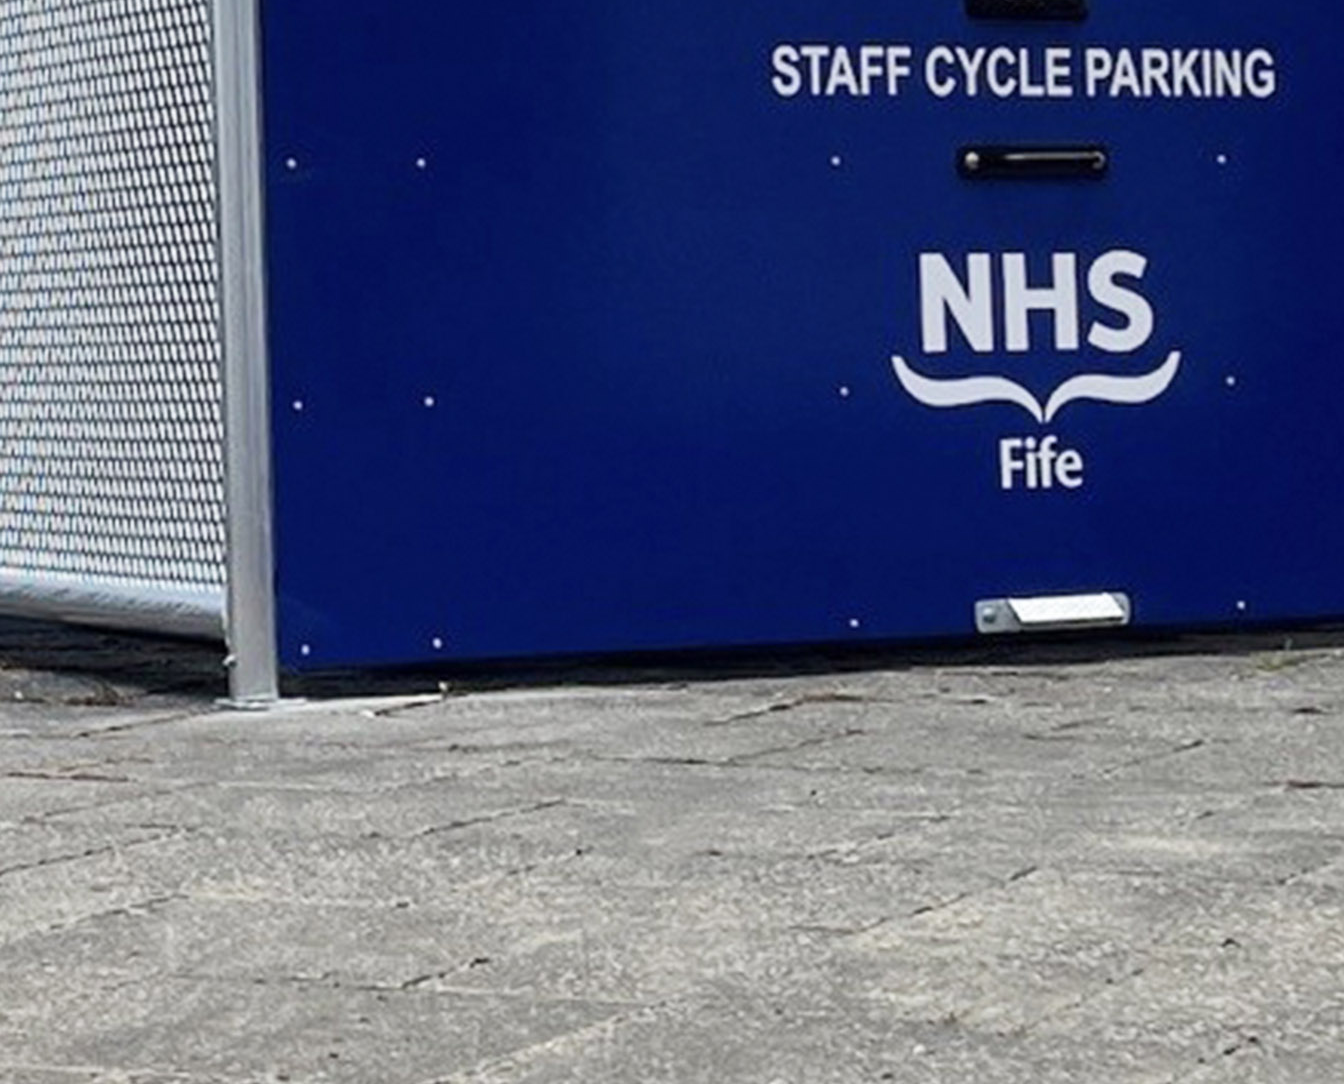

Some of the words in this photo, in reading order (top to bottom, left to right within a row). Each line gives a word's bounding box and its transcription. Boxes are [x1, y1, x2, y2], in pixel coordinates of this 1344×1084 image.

[771, 45, 912, 96] STAFF
[925, 46, 1073, 97] CYCLE
[1085, 48, 1276, 98] PARKING
[918, 249, 1154, 353] NHS
[999, 435, 1083, 490] Fife
